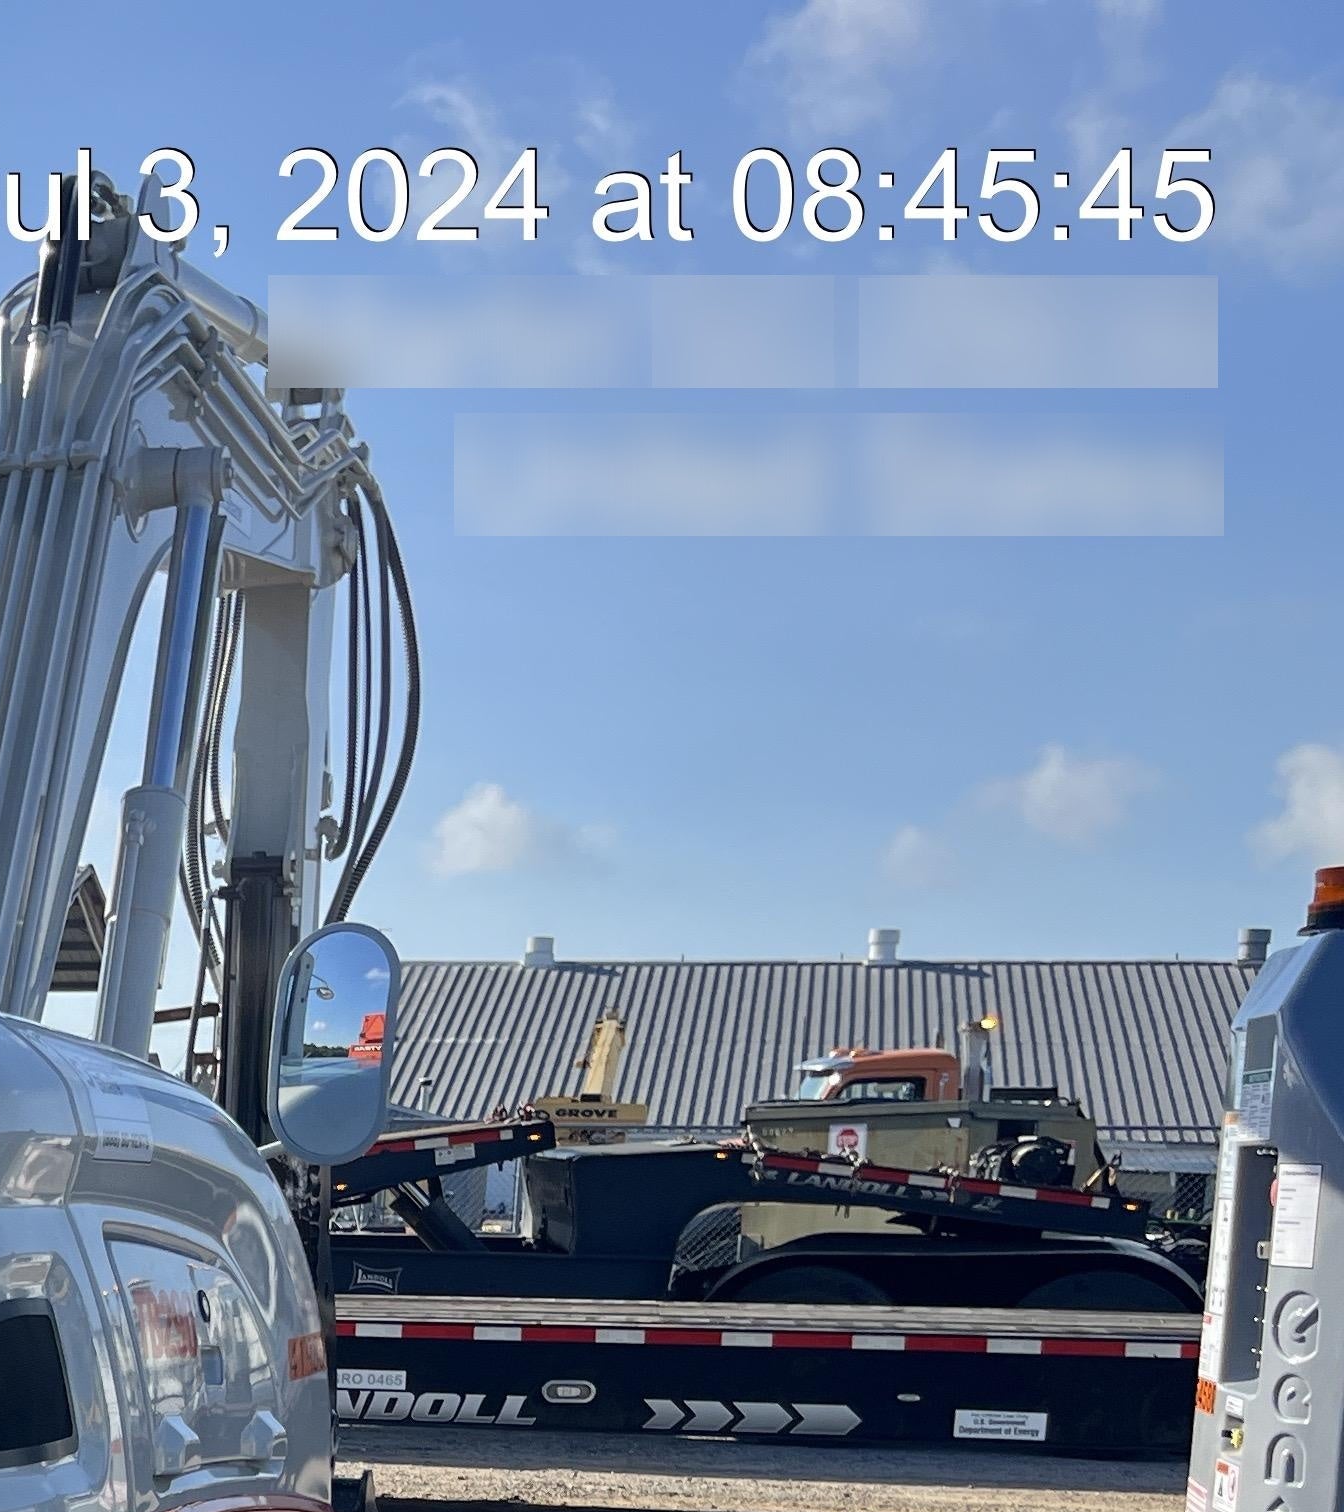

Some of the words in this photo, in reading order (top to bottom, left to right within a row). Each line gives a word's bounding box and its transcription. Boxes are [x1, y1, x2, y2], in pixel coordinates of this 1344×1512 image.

[555, 1108, 618, 1119] GROVE
[337, 1373, 363, 1386] RO
[367, 1373, 403, 1387] 0465
[336, 1389, 537, 1426] NDOLL
